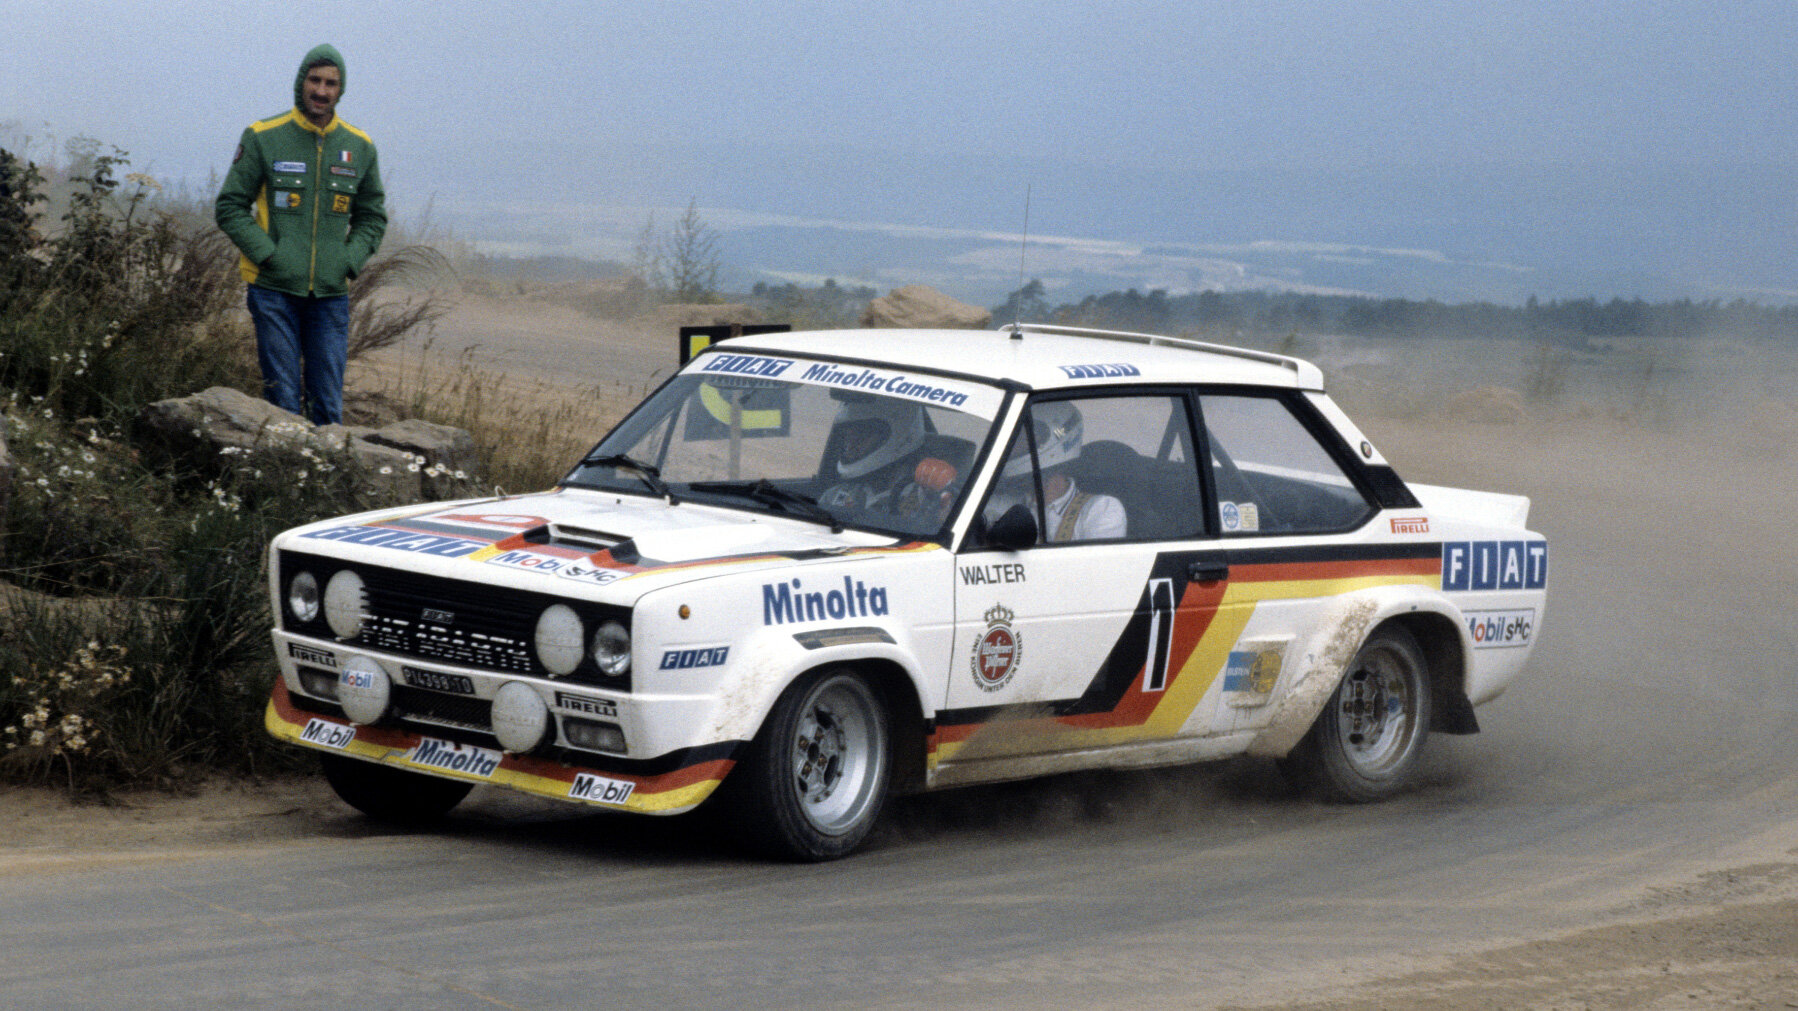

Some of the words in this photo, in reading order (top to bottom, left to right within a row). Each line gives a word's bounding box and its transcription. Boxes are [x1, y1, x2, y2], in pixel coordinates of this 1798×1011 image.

[706, 356, 792, 376] FIAT
[1060, 364, 1138, 377] FIAT
[1390, 517, 1429, 533] PIRELLI
[306, 527, 489, 556] FIAT
[960, 564, 1026, 585] WALTER
[1449, 547, 1544, 584] FIAT
[762, 576, 888, 626] Minolta
[1142, 578, 1175, 693] 1
[288, 642, 337, 668] PIRELLI
[661, 648, 729, 668] FIAT
[342, 670, 372, 688] Mobil
[555, 691, 617, 717] PIRELLI
[302, 720, 354, 747] Mobil
[411, 737, 499, 776] Minolta
[571, 774, 632, 803] Mobil
